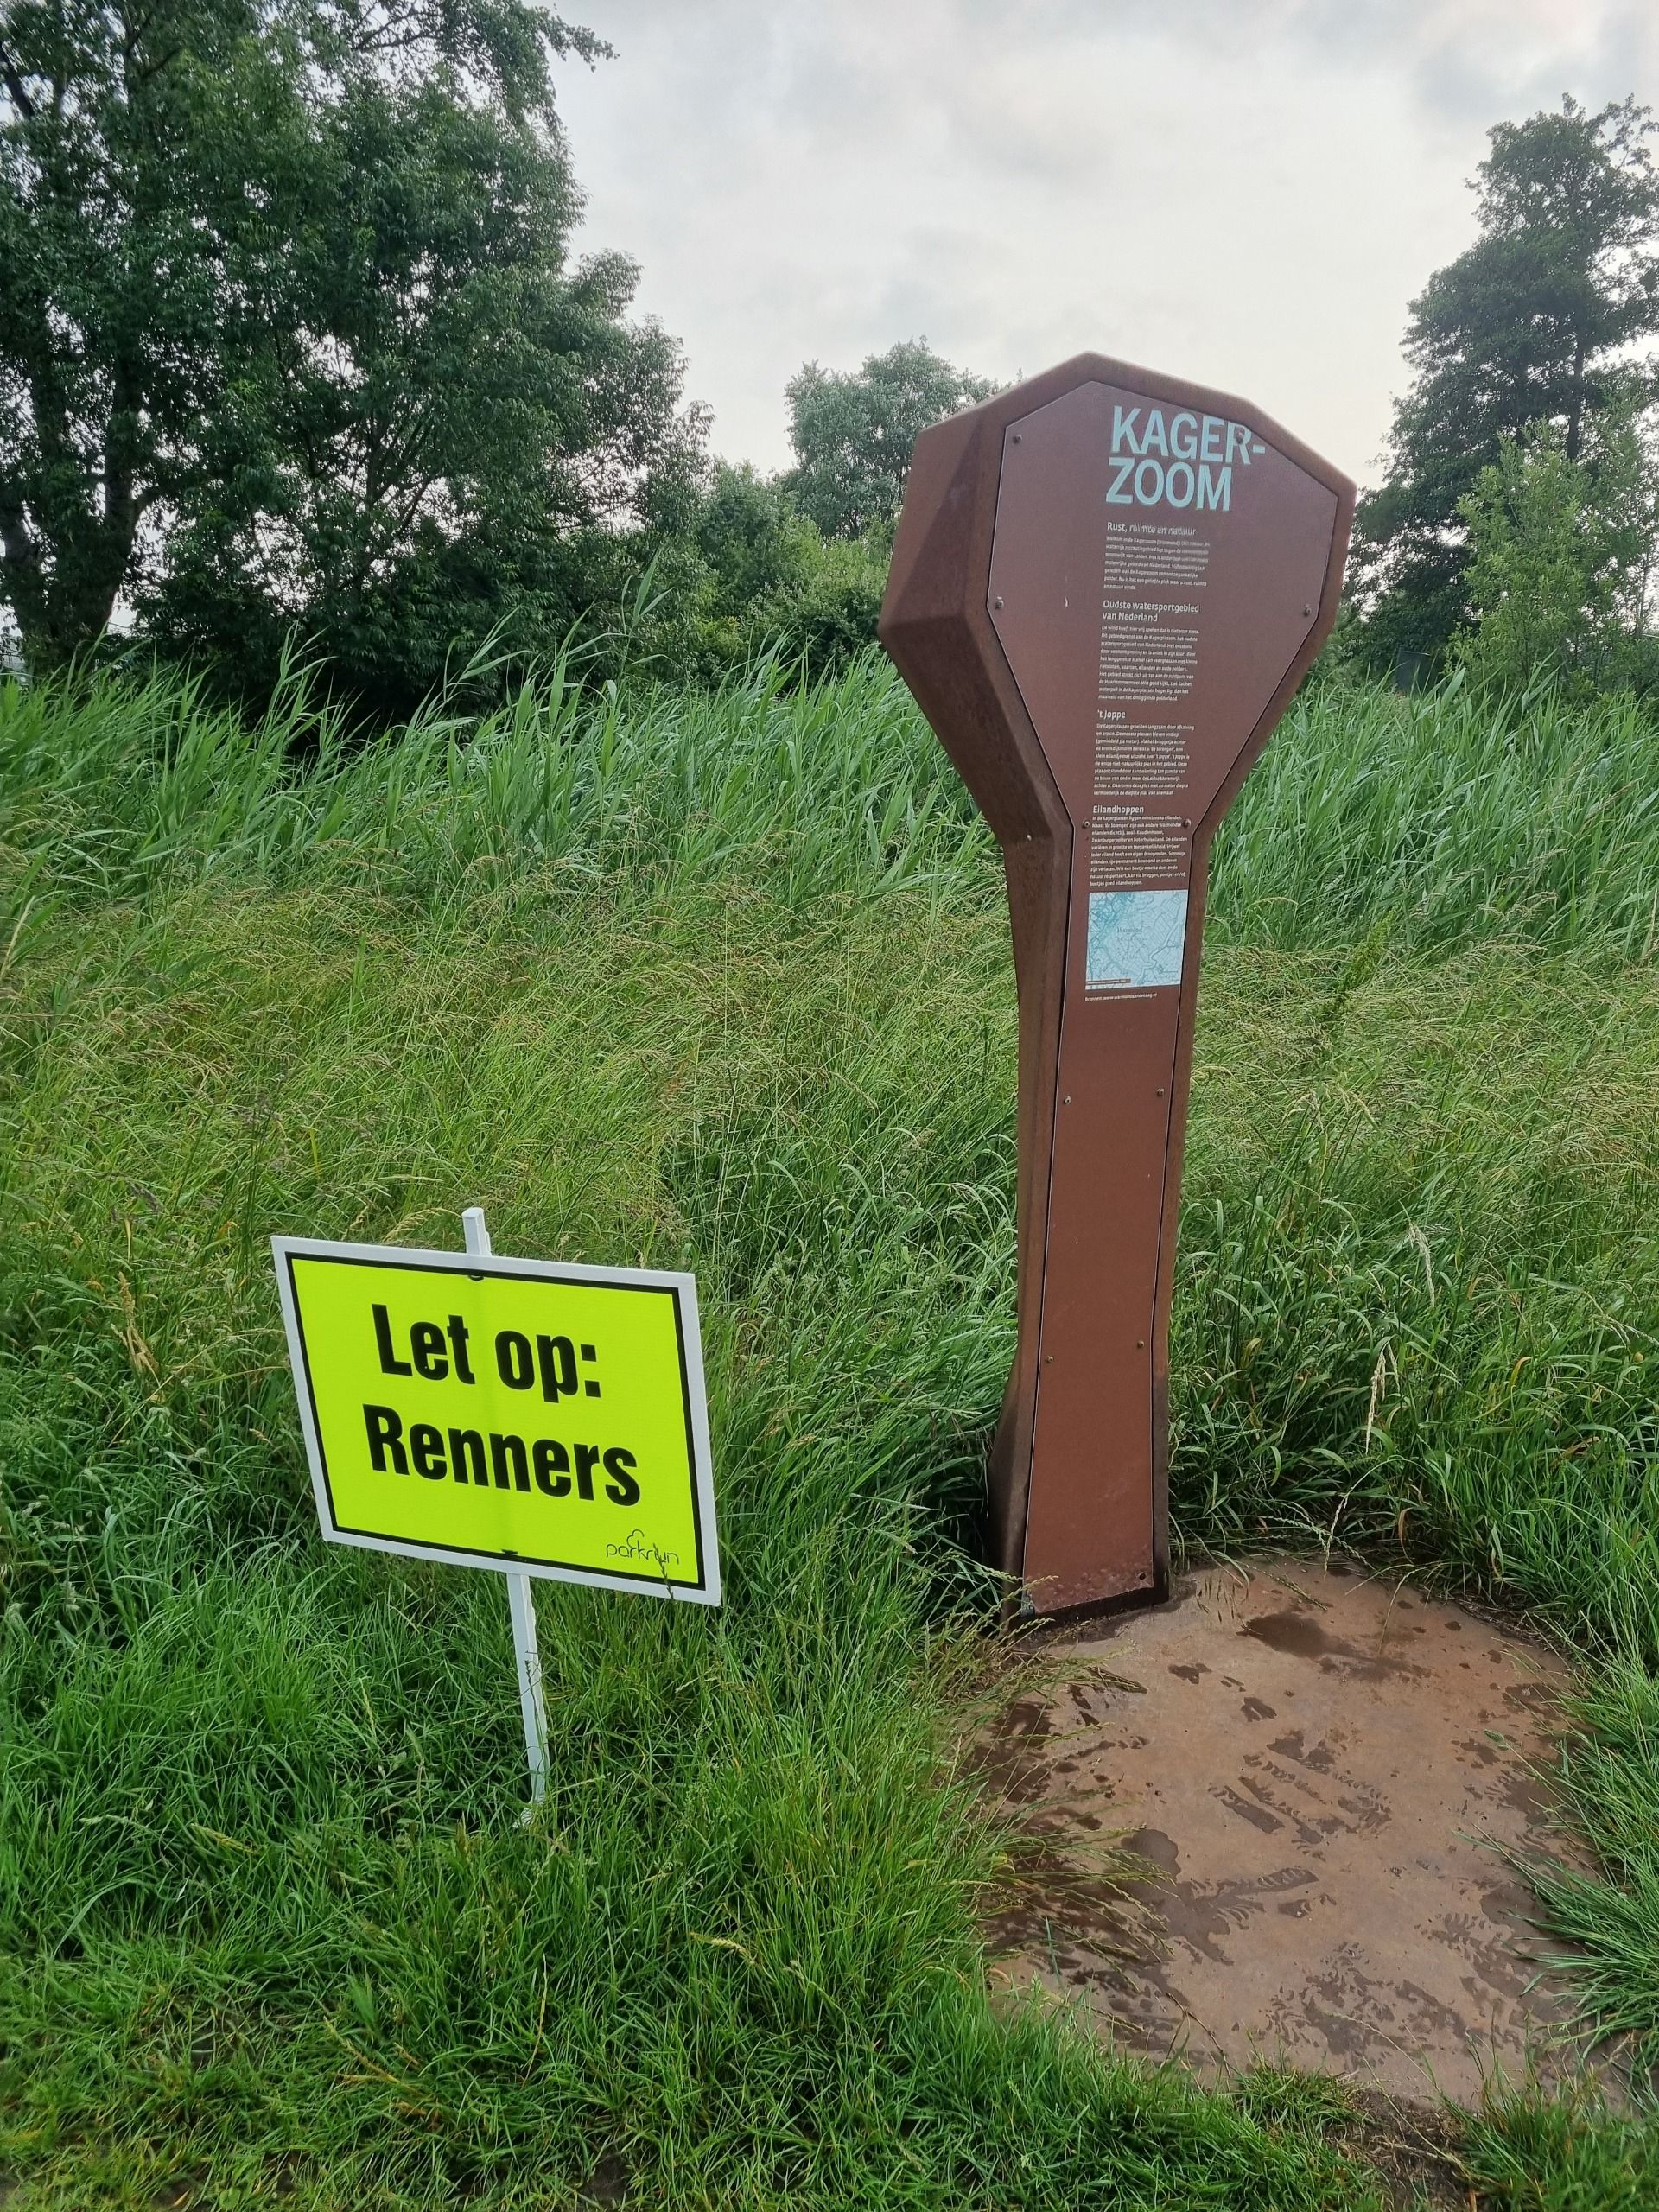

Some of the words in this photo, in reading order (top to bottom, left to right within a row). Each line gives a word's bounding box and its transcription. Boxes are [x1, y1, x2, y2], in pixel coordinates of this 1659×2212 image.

[1112, 405, 1266, 465] KAGER-
[1105, 456, 1233, 512] ZOOM
[1107, 522, 1128, 532] Rust,
[1129, 523, 1155, 534] ruimte
[1168, 526, 1197, 536] natuur
[1103, 600, 1132, 609] Oudste
[1133, 601, 1199, 613] watersportgebied
[1119, 612, 1158, 622] Nederland
[1104, 710, 1126, 720] Joppe
[1093, 805, 1144, 815] Eilandhoppen
[372, 1303, 476, 1385] Let
[494, 1330, 601, 1404] op:
[362, 1402, 641, 1507] Renners
